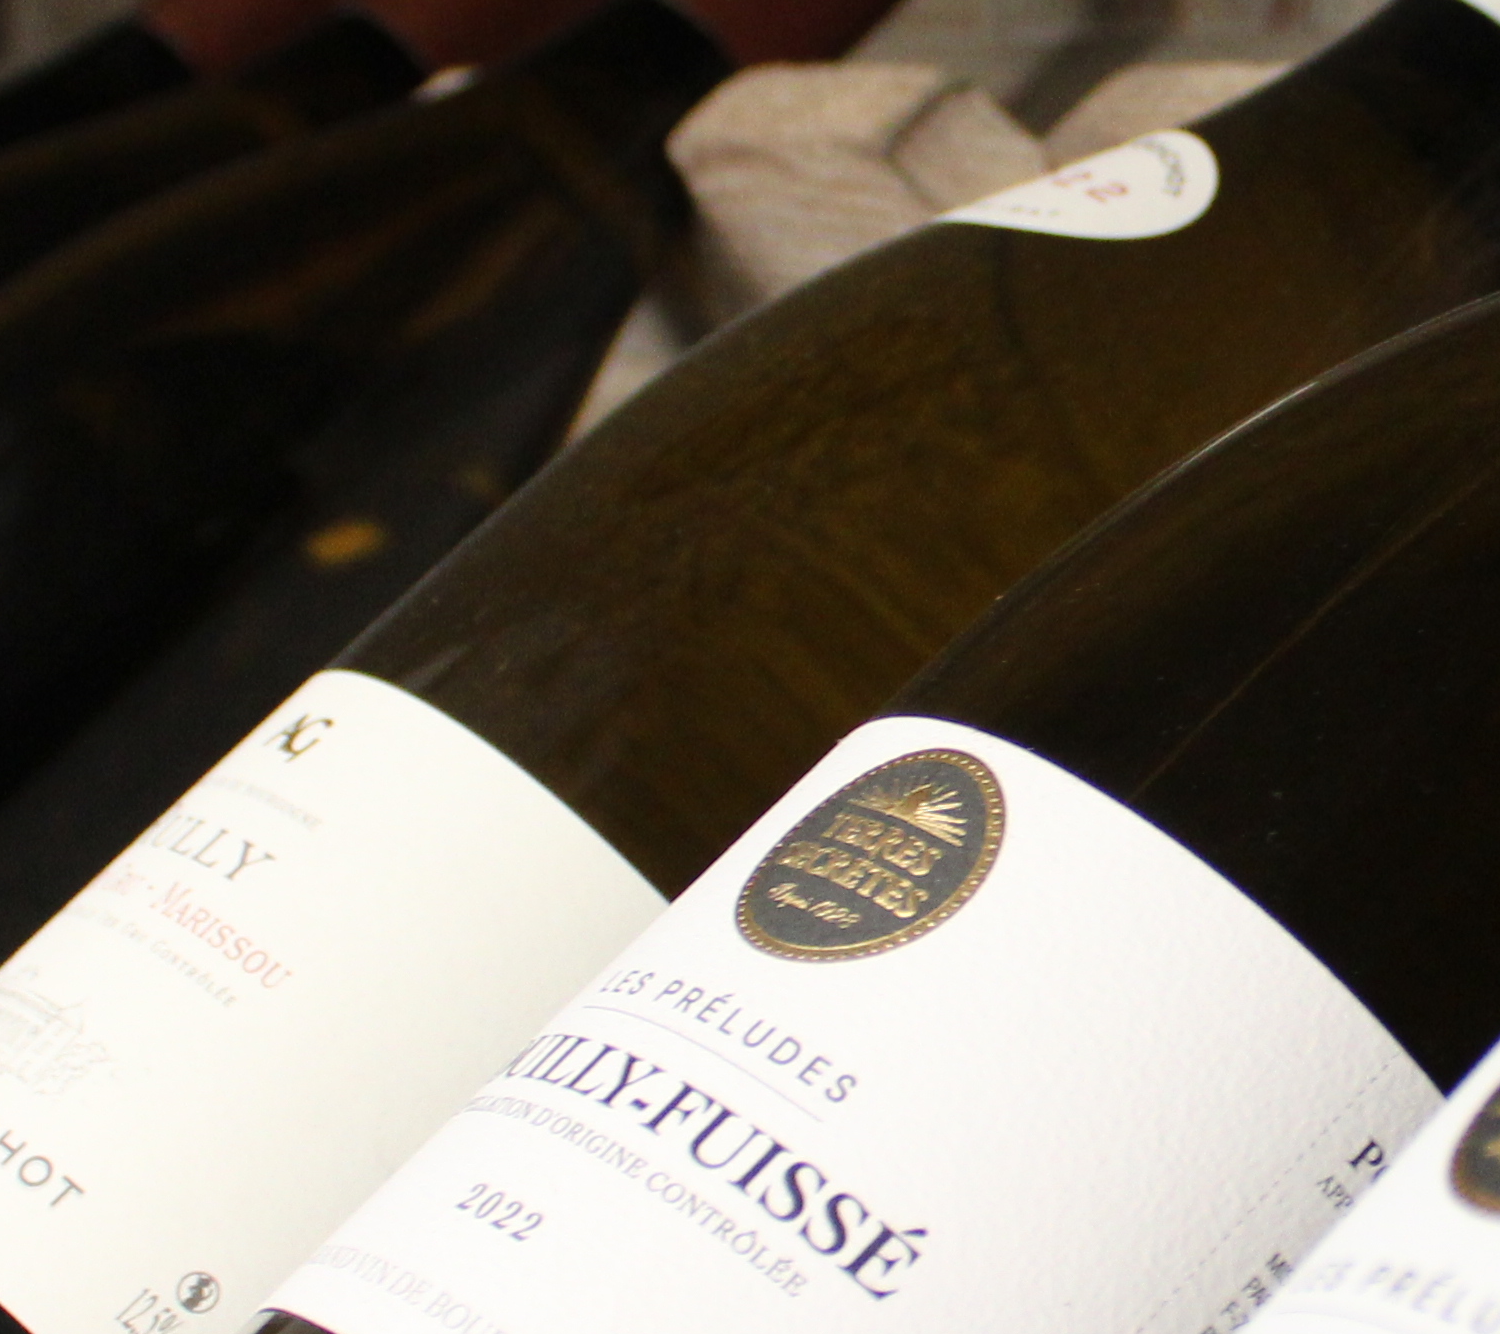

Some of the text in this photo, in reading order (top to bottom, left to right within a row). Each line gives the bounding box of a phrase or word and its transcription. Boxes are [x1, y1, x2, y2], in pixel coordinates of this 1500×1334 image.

[262, 714, 335, 763] AG
[151, 815, 276, 881] ULLY
[657, 979, 857, 1104] PRÉLUDES
[455, 1183, 544, 1242] 2022
[502, 1033, 929, 1301] UILLY-FUISSÉ
[645, 1172, 809, 1298] CONTRÔLÉE
